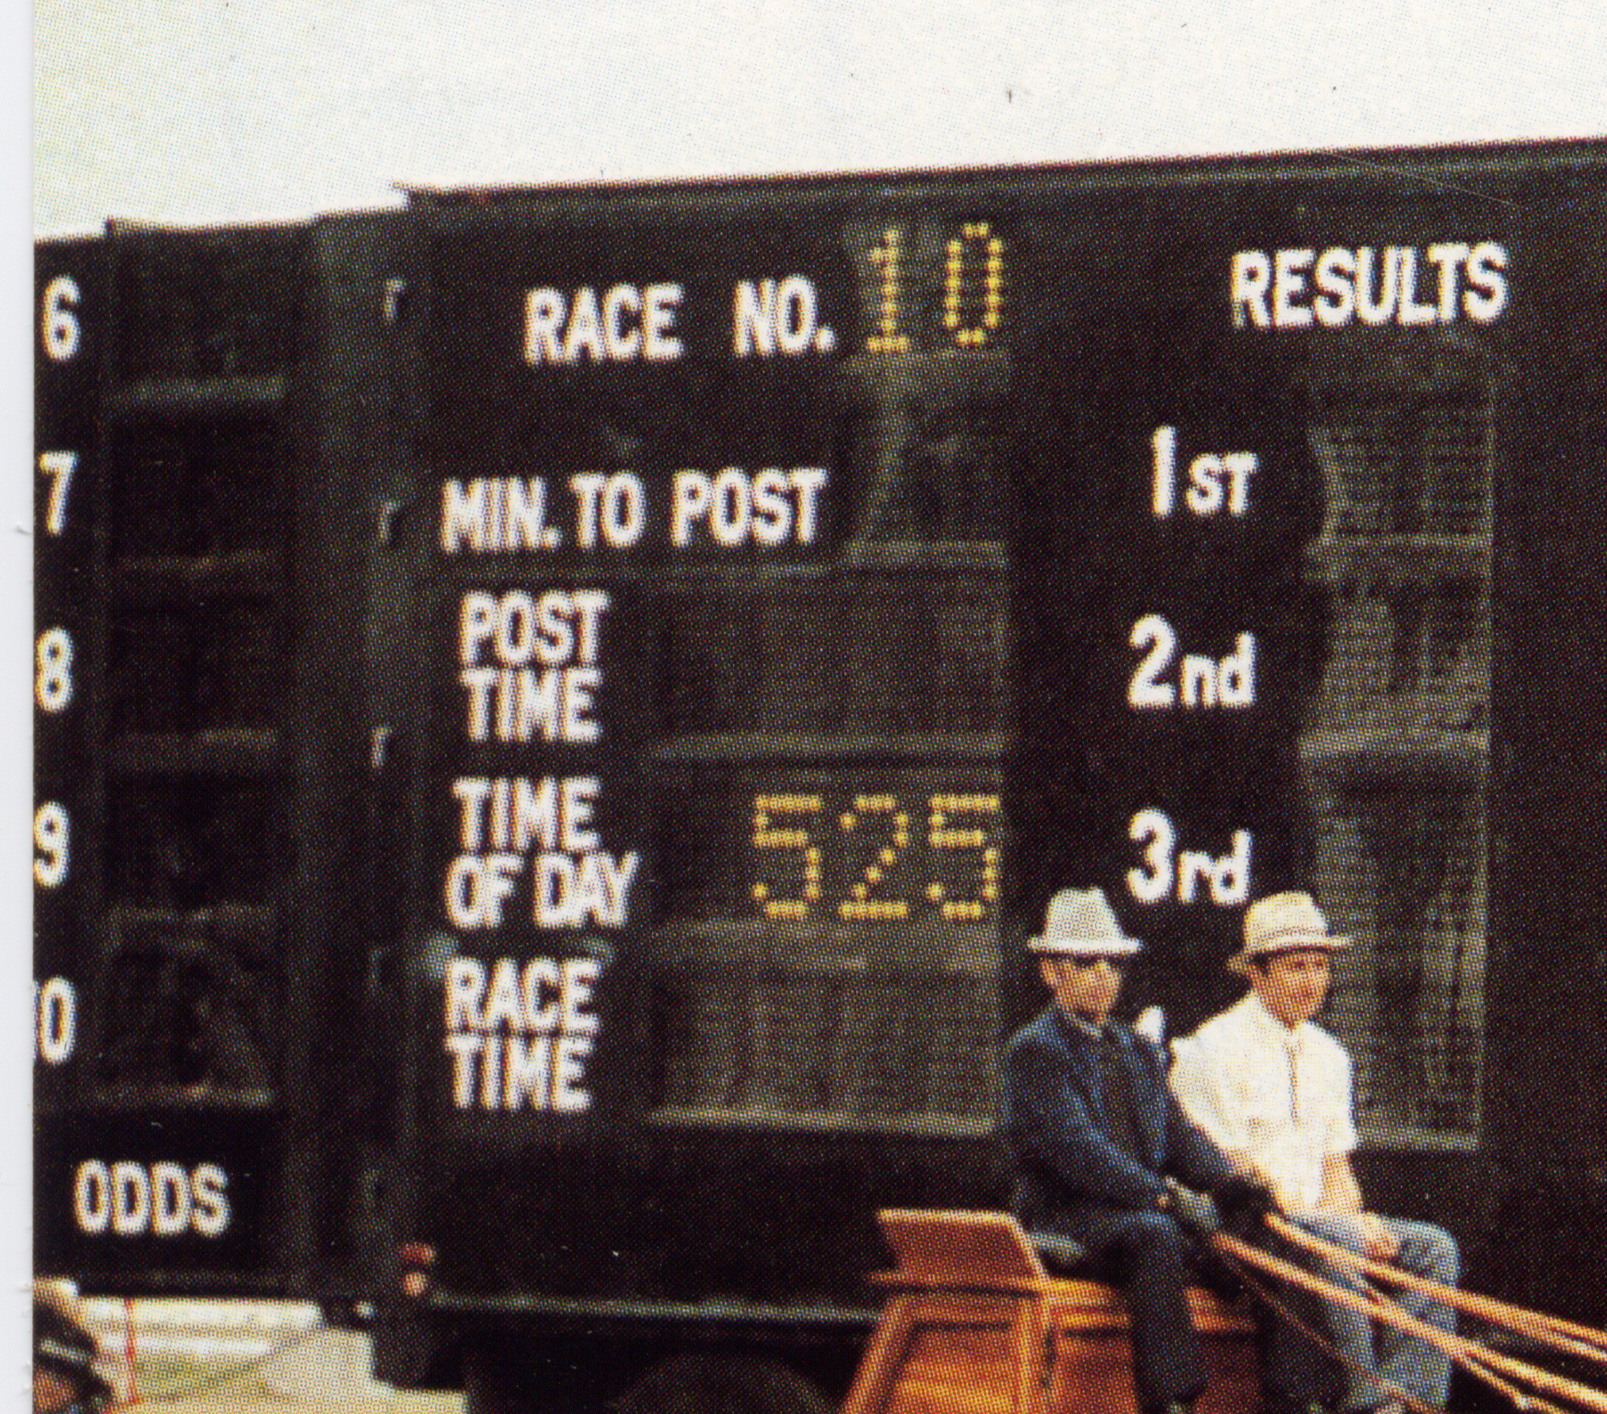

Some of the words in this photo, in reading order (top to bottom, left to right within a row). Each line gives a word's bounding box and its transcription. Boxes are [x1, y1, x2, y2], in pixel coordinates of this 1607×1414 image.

[44, 276, 80, 360] 6
[526, 283, 683, 363] RACE
[735, 274, 836, 357] NO.
[867, 223, 1002, 353] 10
[1231, 241, 1509, 328] RESULTS
[41, 451, 77, 534] 7
[442, 476, 562, 552] MIN.
[570, 471, 646, 548] TO
[672, 466, 828, 548] POST
[1152, 425, 1259, 518] 1ST
[36, 627, 73, 712] 8
[461, 589, 609, 668] POST
[1127, 613, 1257, 709] 2nd
[461, 667, 602, 743] TIME
[33, 801, 69, 888] 9
[453, 777, 601, 852] TIME
[753, 794, 1000, 918] 525
[1127, 808, 1252, 905] 3rd
[447, 852, 524, 929] OF
[535, 850, 639, 928] DAY
[443, 957, 601, 1033] RACE
[446, 1033, 593, 1112] TIME
[75, 1159, 230, 1235] ODDS
